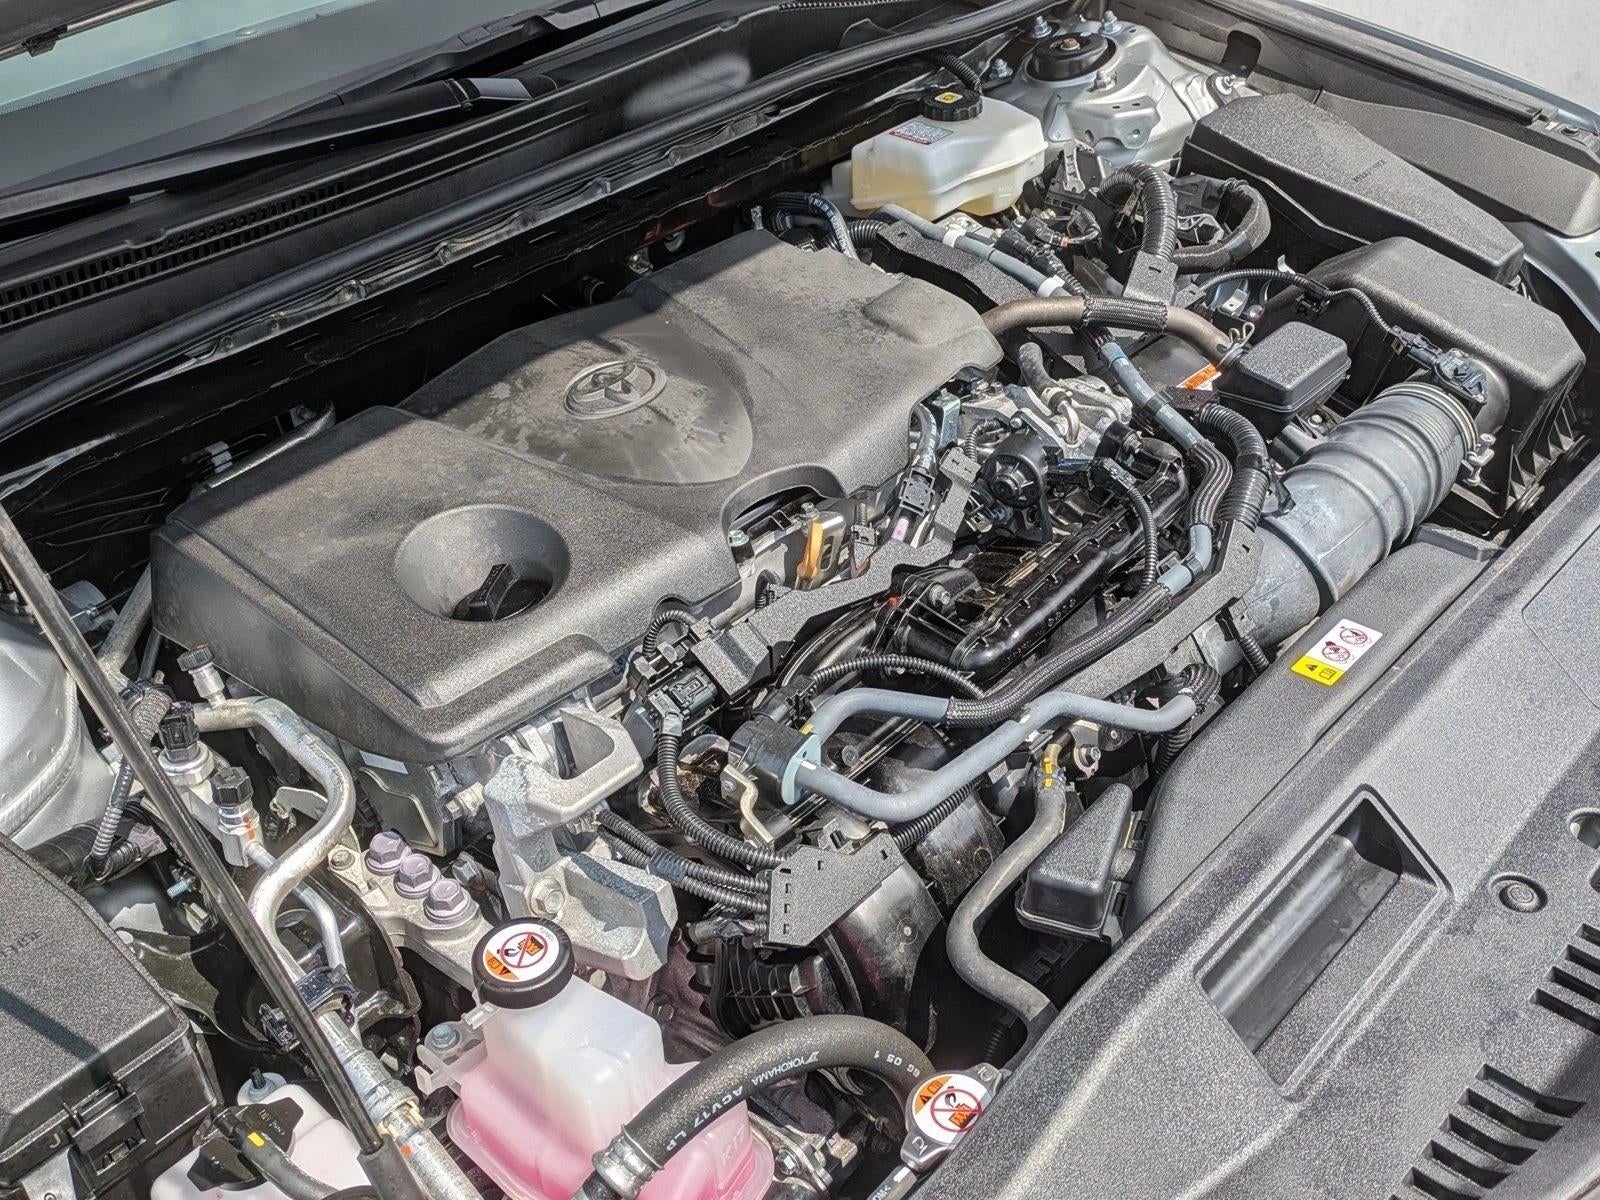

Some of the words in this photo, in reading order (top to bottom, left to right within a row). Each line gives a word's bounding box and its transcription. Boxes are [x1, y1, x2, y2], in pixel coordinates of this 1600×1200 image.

[751, 1056, 805, 1086] YOKOHAMA
[694, 1085, 743, 1128] ACV17
[666, 1130, 687, 1151] LP
